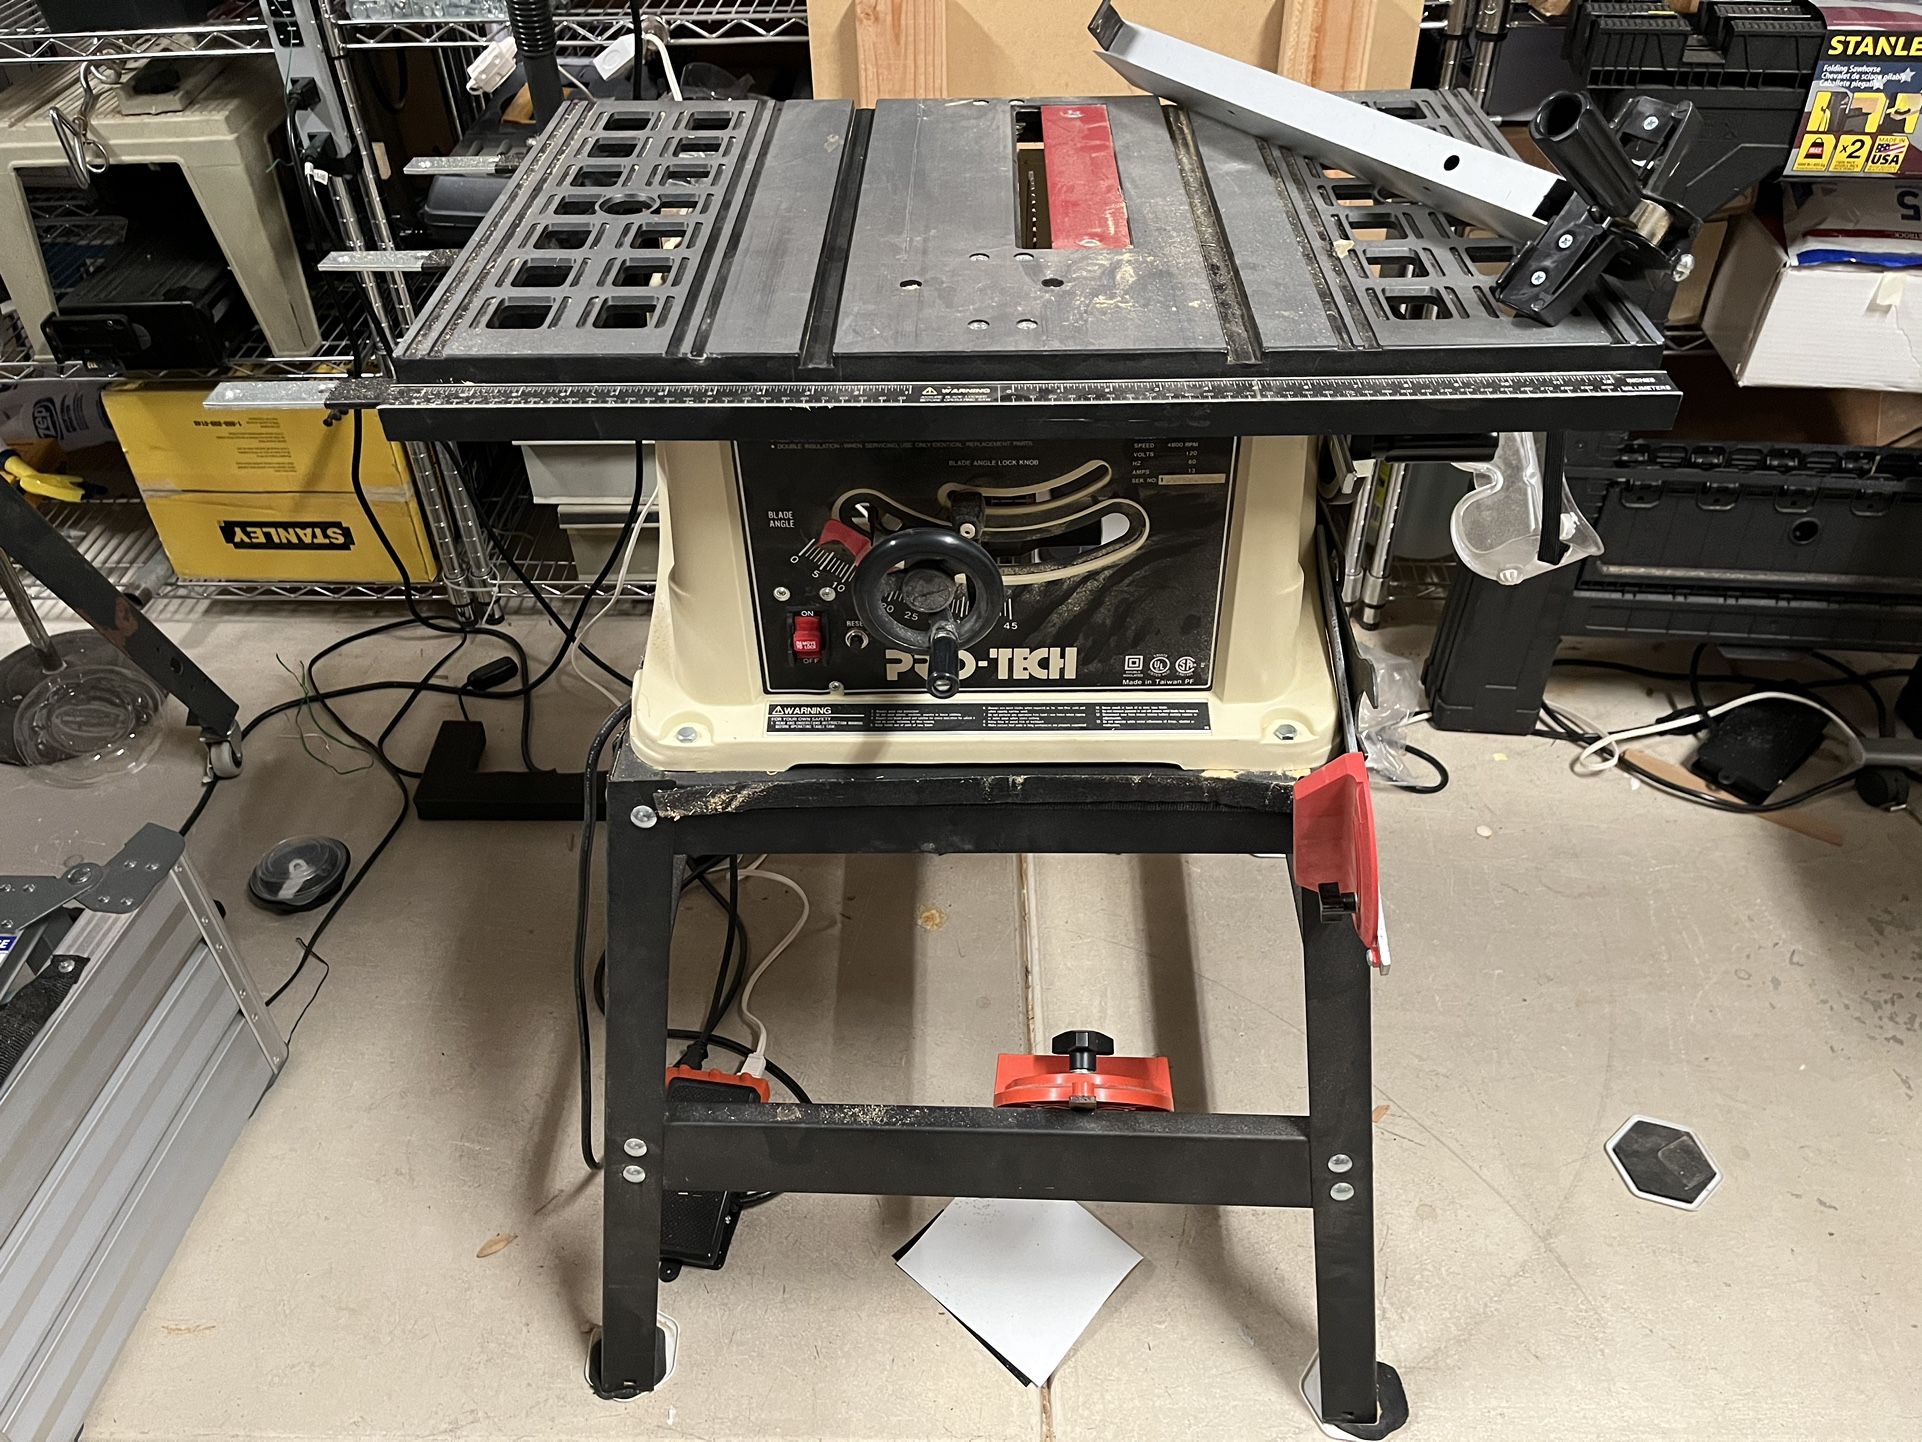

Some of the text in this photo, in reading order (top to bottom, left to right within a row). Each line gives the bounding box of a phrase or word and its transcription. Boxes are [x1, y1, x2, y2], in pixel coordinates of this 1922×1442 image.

[1823, 64, 1881, 73] Folding Sawhorse
[1821, 72, 1851, 80] Chevalet
[1851, 72, 1860, 80] de
[1871, 155, 1900, 165] USA
[768, 511, 793, 519] BLADE
[769, 520, 795, 528] ANGLE
[234, 527, 345, 544] STANLEY
[811, 570, 820, 578] 5
[832, 581, 846, 592] 10
[904, 611, 919, 621] 25
[1003, 622, 1018, 630] 45
[784, 706, 832, 715] WARNING
